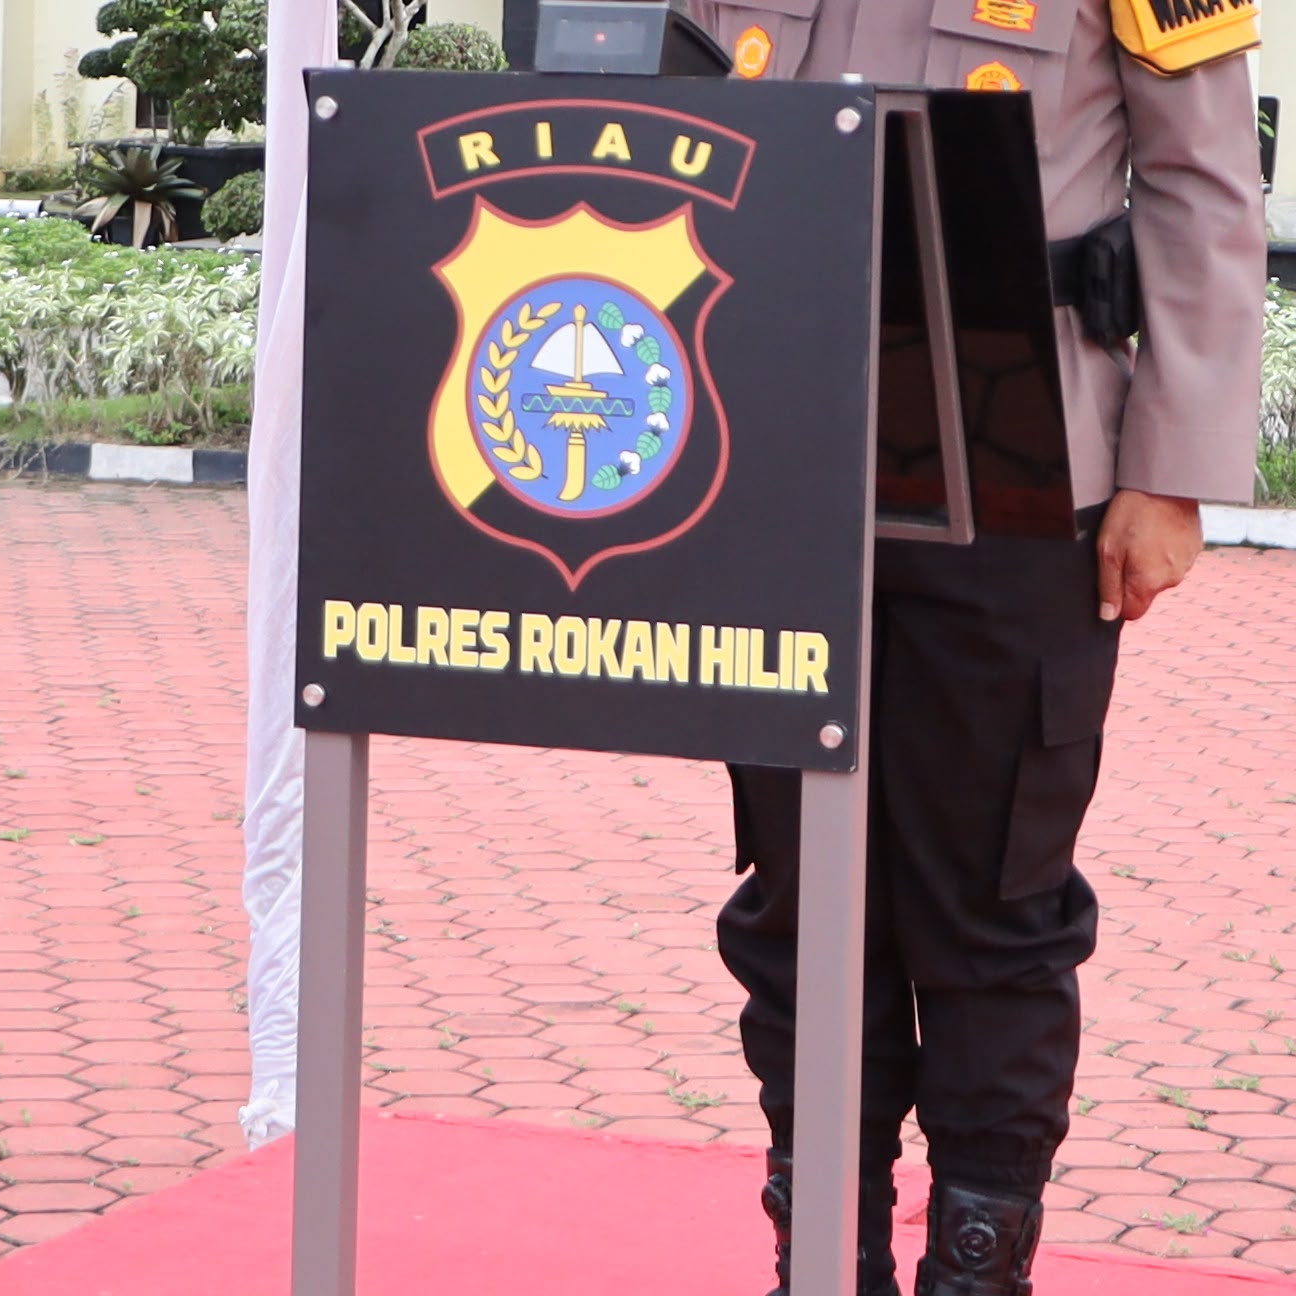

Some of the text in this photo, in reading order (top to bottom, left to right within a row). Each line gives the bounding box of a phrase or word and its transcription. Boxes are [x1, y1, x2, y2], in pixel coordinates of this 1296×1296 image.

[458, 121, 713, 177] RIAU
[322, 599, 830, 694] POLRES ROKAN HILIR
